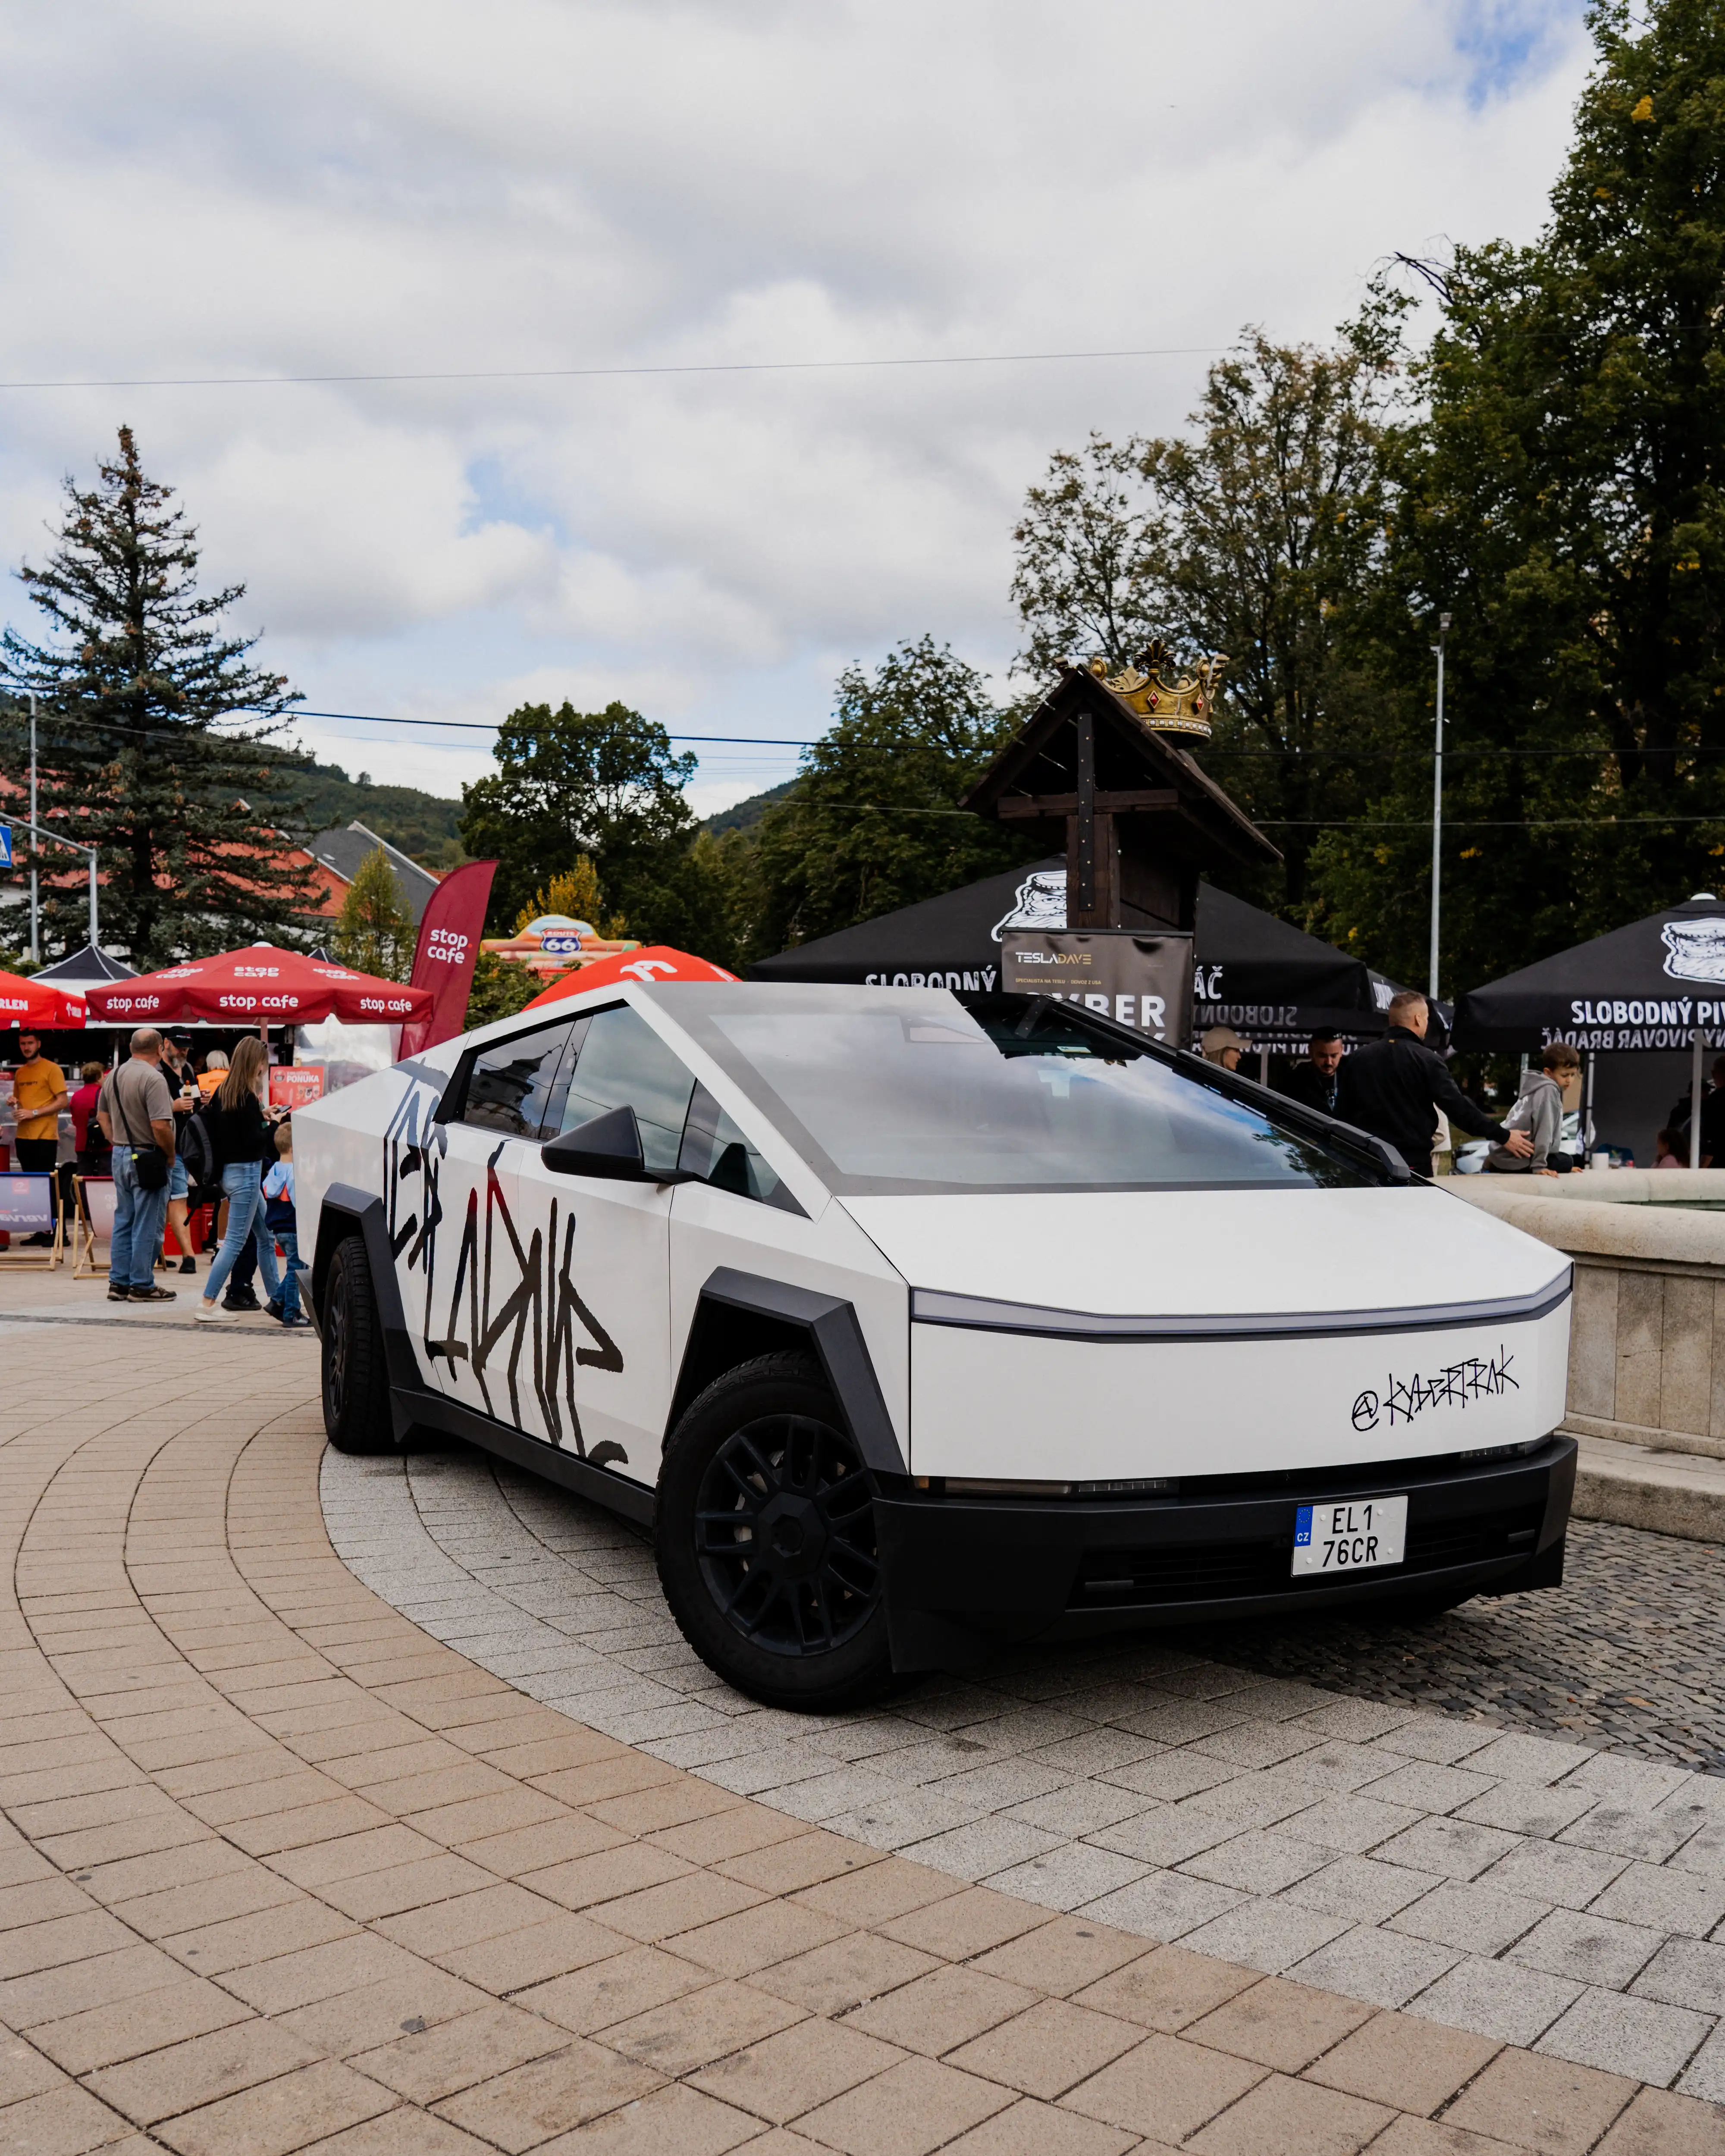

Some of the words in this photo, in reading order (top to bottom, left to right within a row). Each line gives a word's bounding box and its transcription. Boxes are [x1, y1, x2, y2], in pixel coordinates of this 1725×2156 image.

[546, 939, 576, 951] 66
[427, 946, 464, 964] cafe
[1571, 997, 1692, 1025] SLOBODNÝ
[1297, 1532, 1309, 1542] CZ
[1322, 1536, 1378, 1567] 76CR
